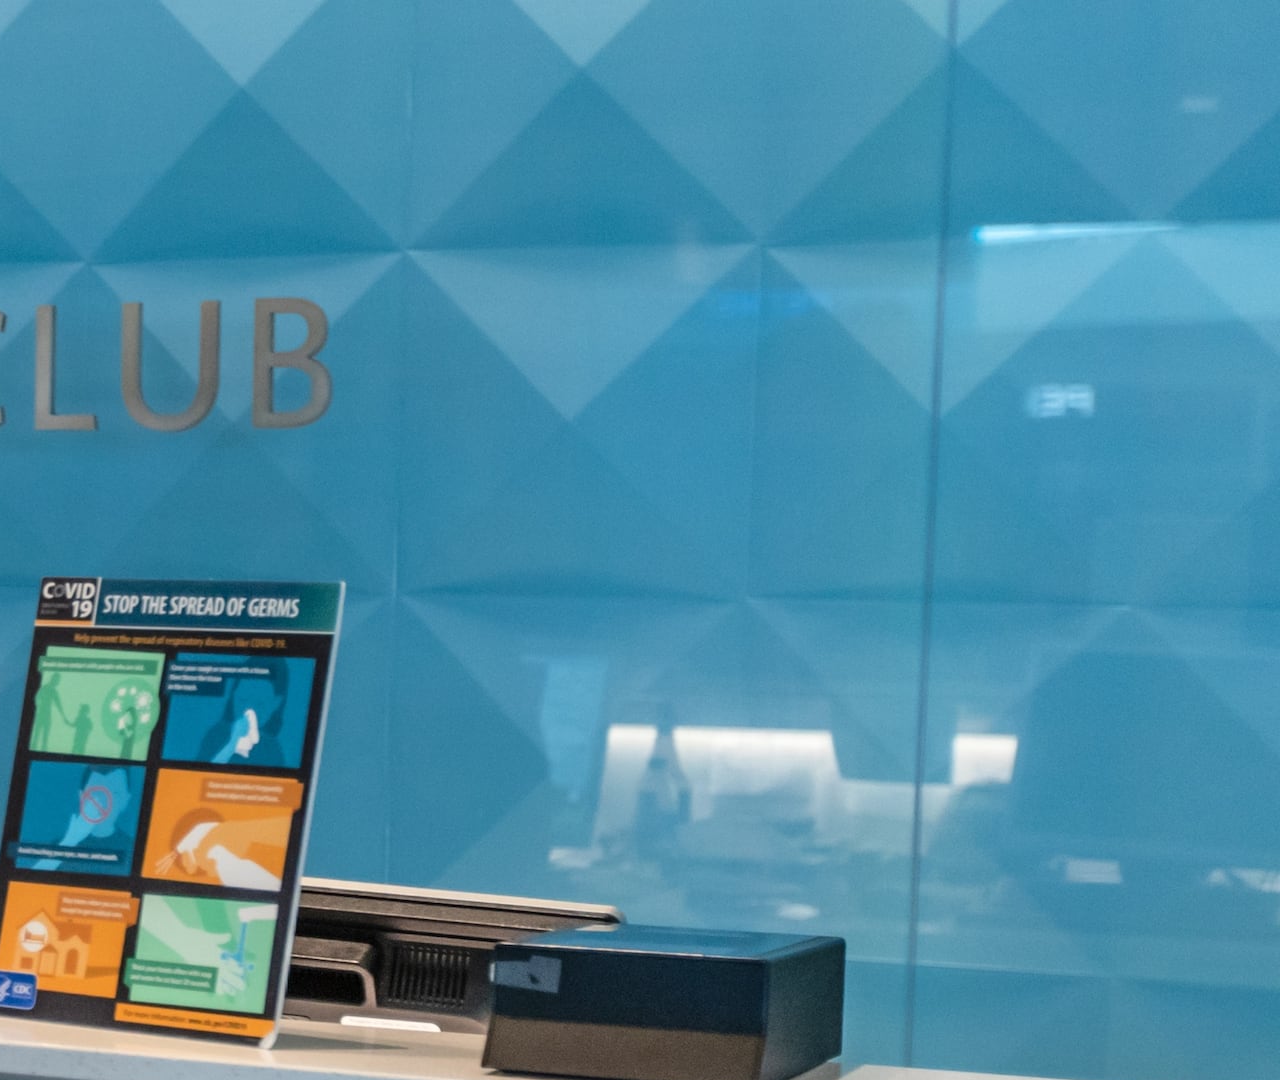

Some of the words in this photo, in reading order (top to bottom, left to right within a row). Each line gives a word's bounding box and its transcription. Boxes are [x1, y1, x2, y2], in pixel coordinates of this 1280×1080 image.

[71, 600, 93, 618] 19
[102, 594, 140, 614] STOP
[140, 595, 169, 615] THE
[168, 596, 226, 616] SPREAD
[225, 597, 248, 617] OF
[247, 598, 301, 618] GERMS
